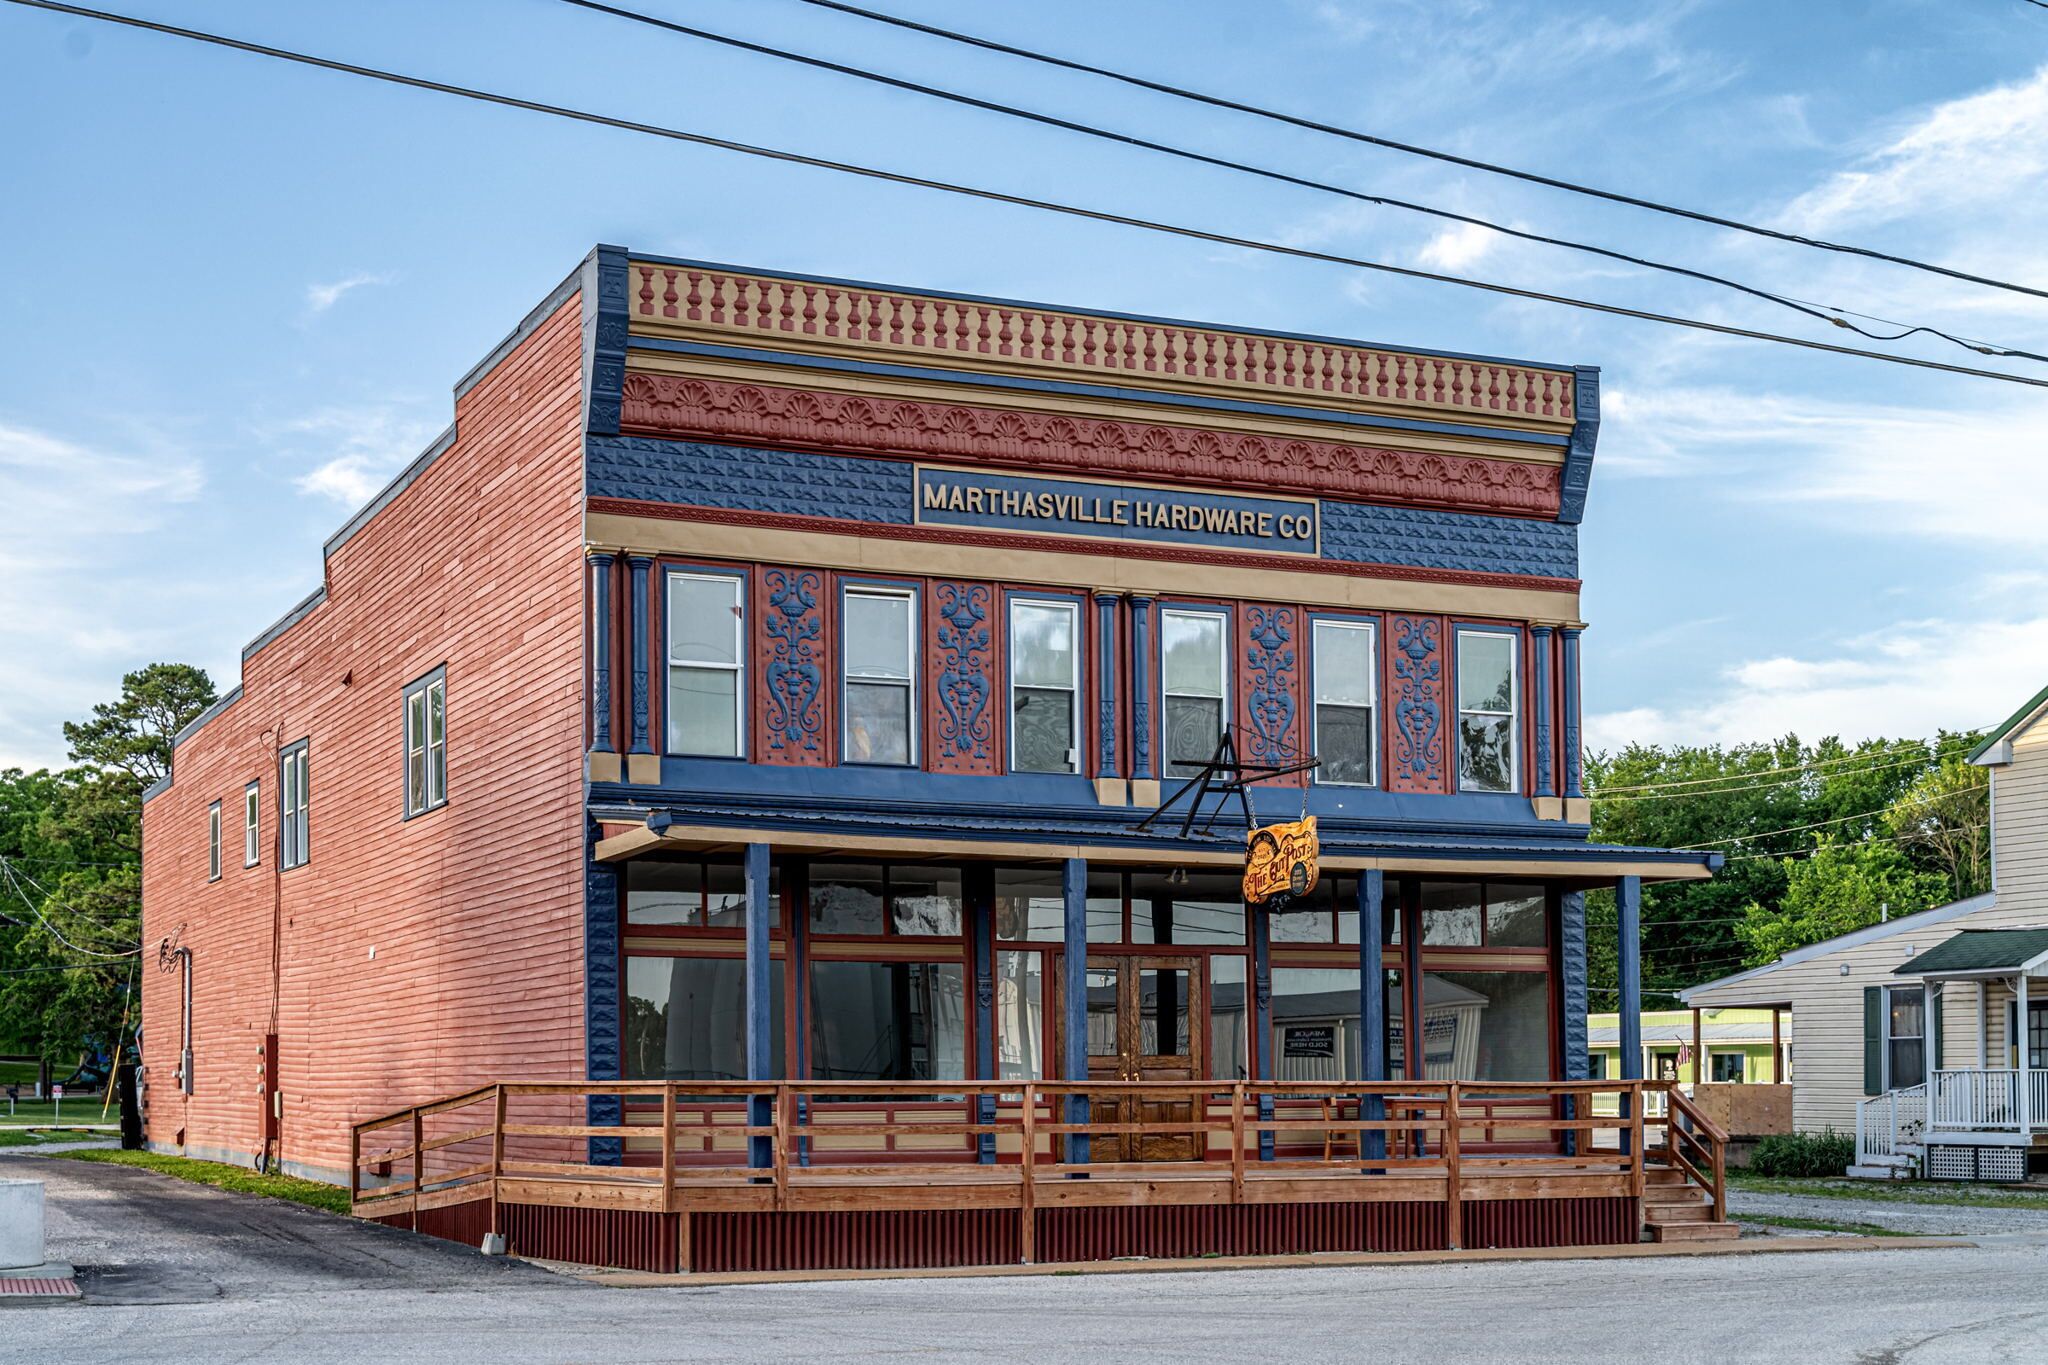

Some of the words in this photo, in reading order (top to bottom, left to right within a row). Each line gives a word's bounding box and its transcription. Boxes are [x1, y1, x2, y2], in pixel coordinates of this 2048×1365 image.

[924, 483, 1129, 525] MARTHASVILLE
[1135, 501, 1273, 537] HARDWARE
[1279, 514, 1312, 540] CO
[1249, 872, 1268, 897] THE
